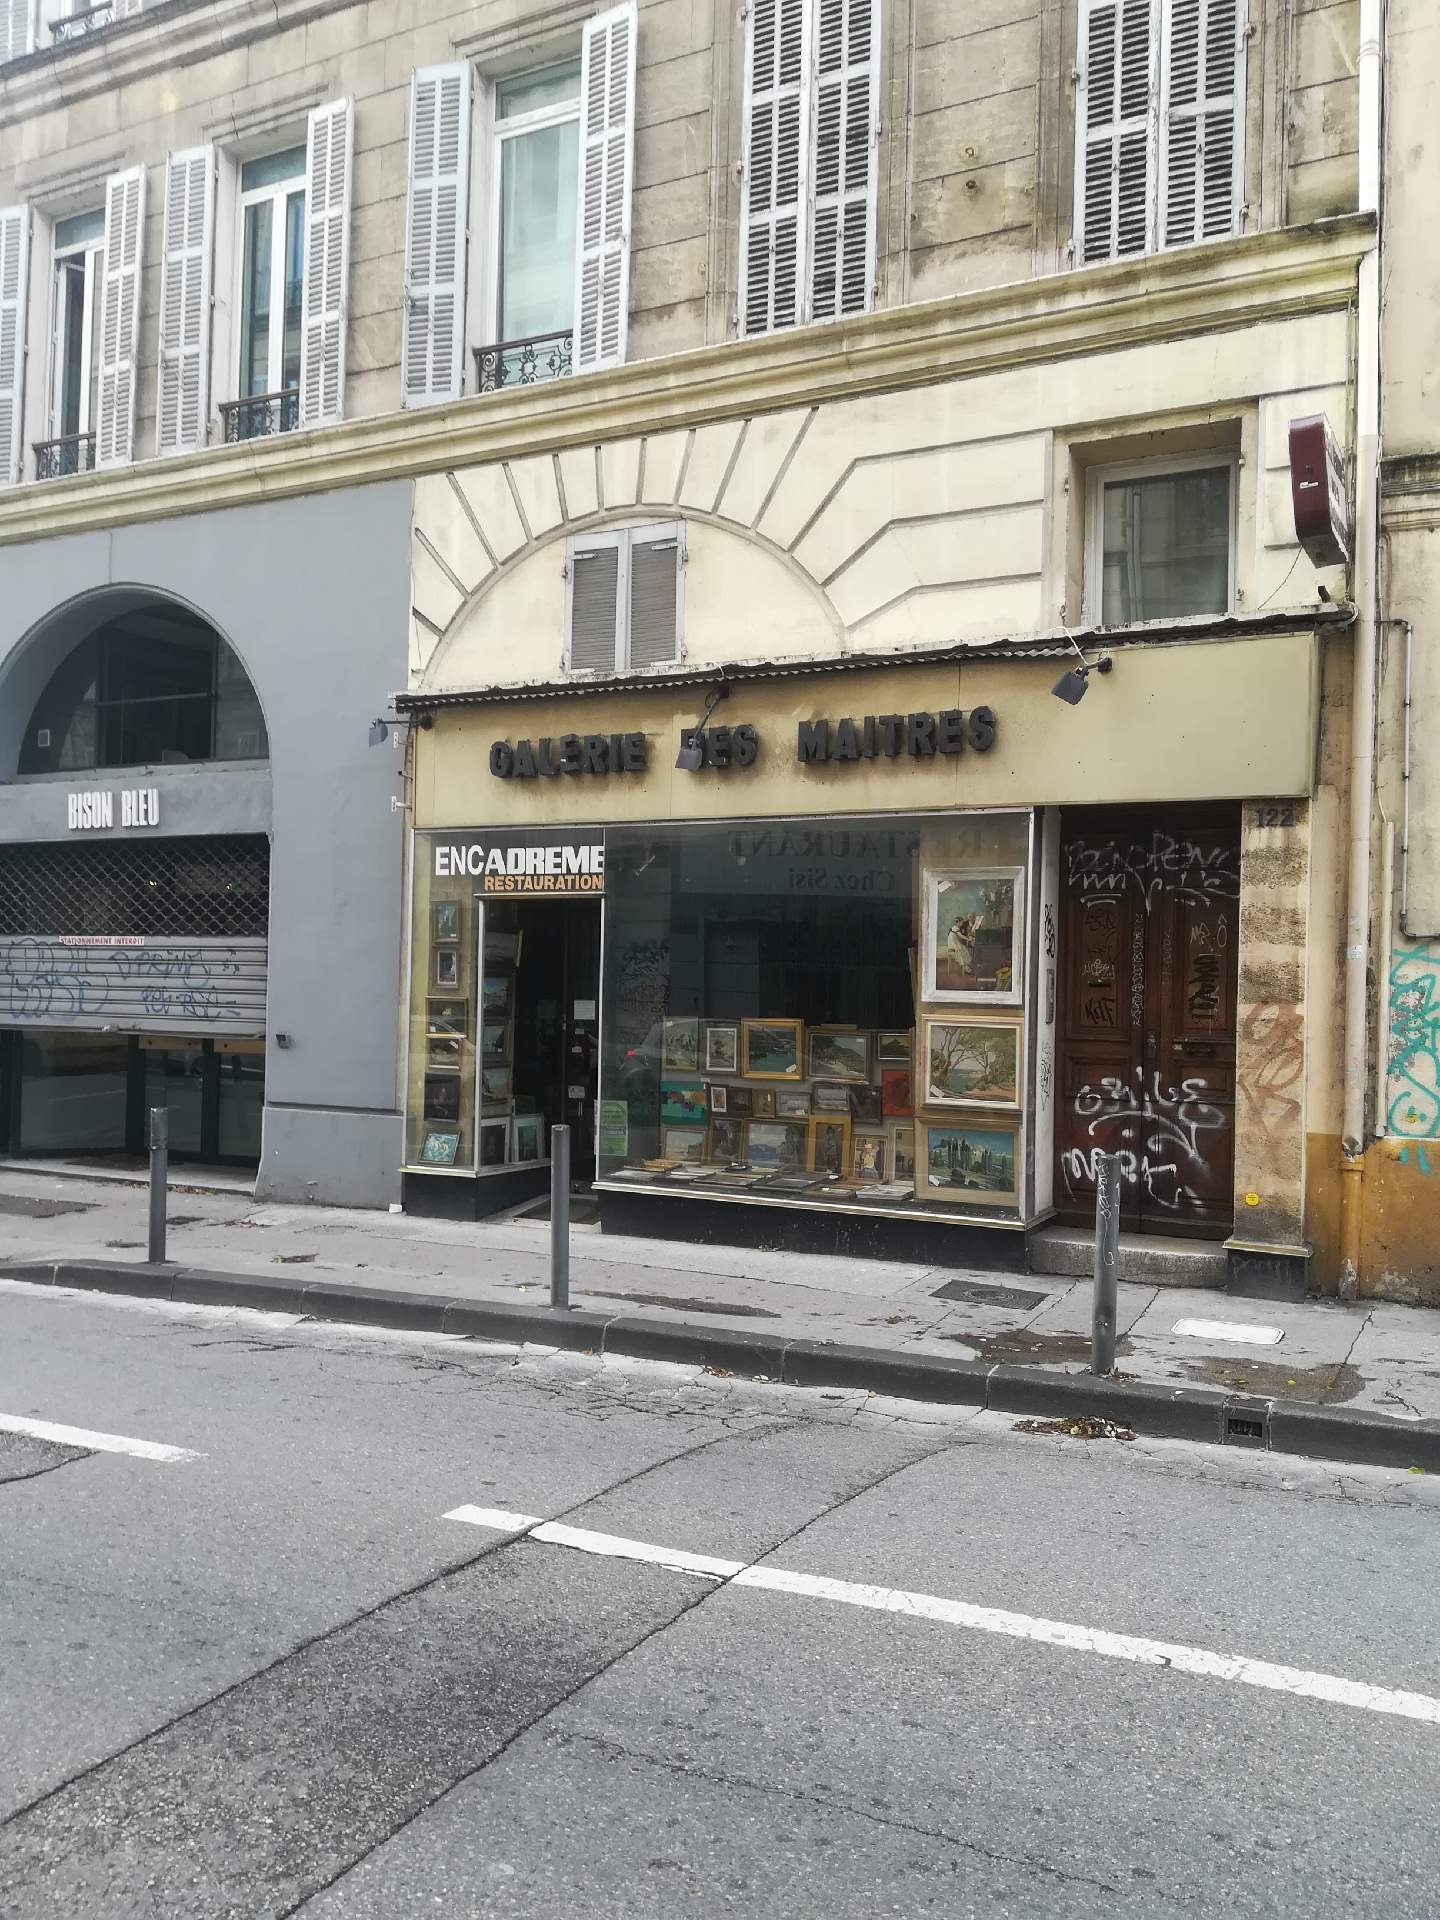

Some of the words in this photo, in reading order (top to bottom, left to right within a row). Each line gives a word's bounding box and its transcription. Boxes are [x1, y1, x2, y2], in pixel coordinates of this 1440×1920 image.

[489, 732, 649, 778] GALERIE
[680, 724, 758, 768] DES
[798, 705, 996, 761] MAITRES
[68, 791, 113, 829] BISON
[121, 788, 160, 827] BLEU
[1257, 808, 1296, 828] 122
[484, 875, 604, 891] RESTAURATION
[60, 936, 112, 945] STATIONNEMENT
[114, 936, 144, 945] INTERDIT
